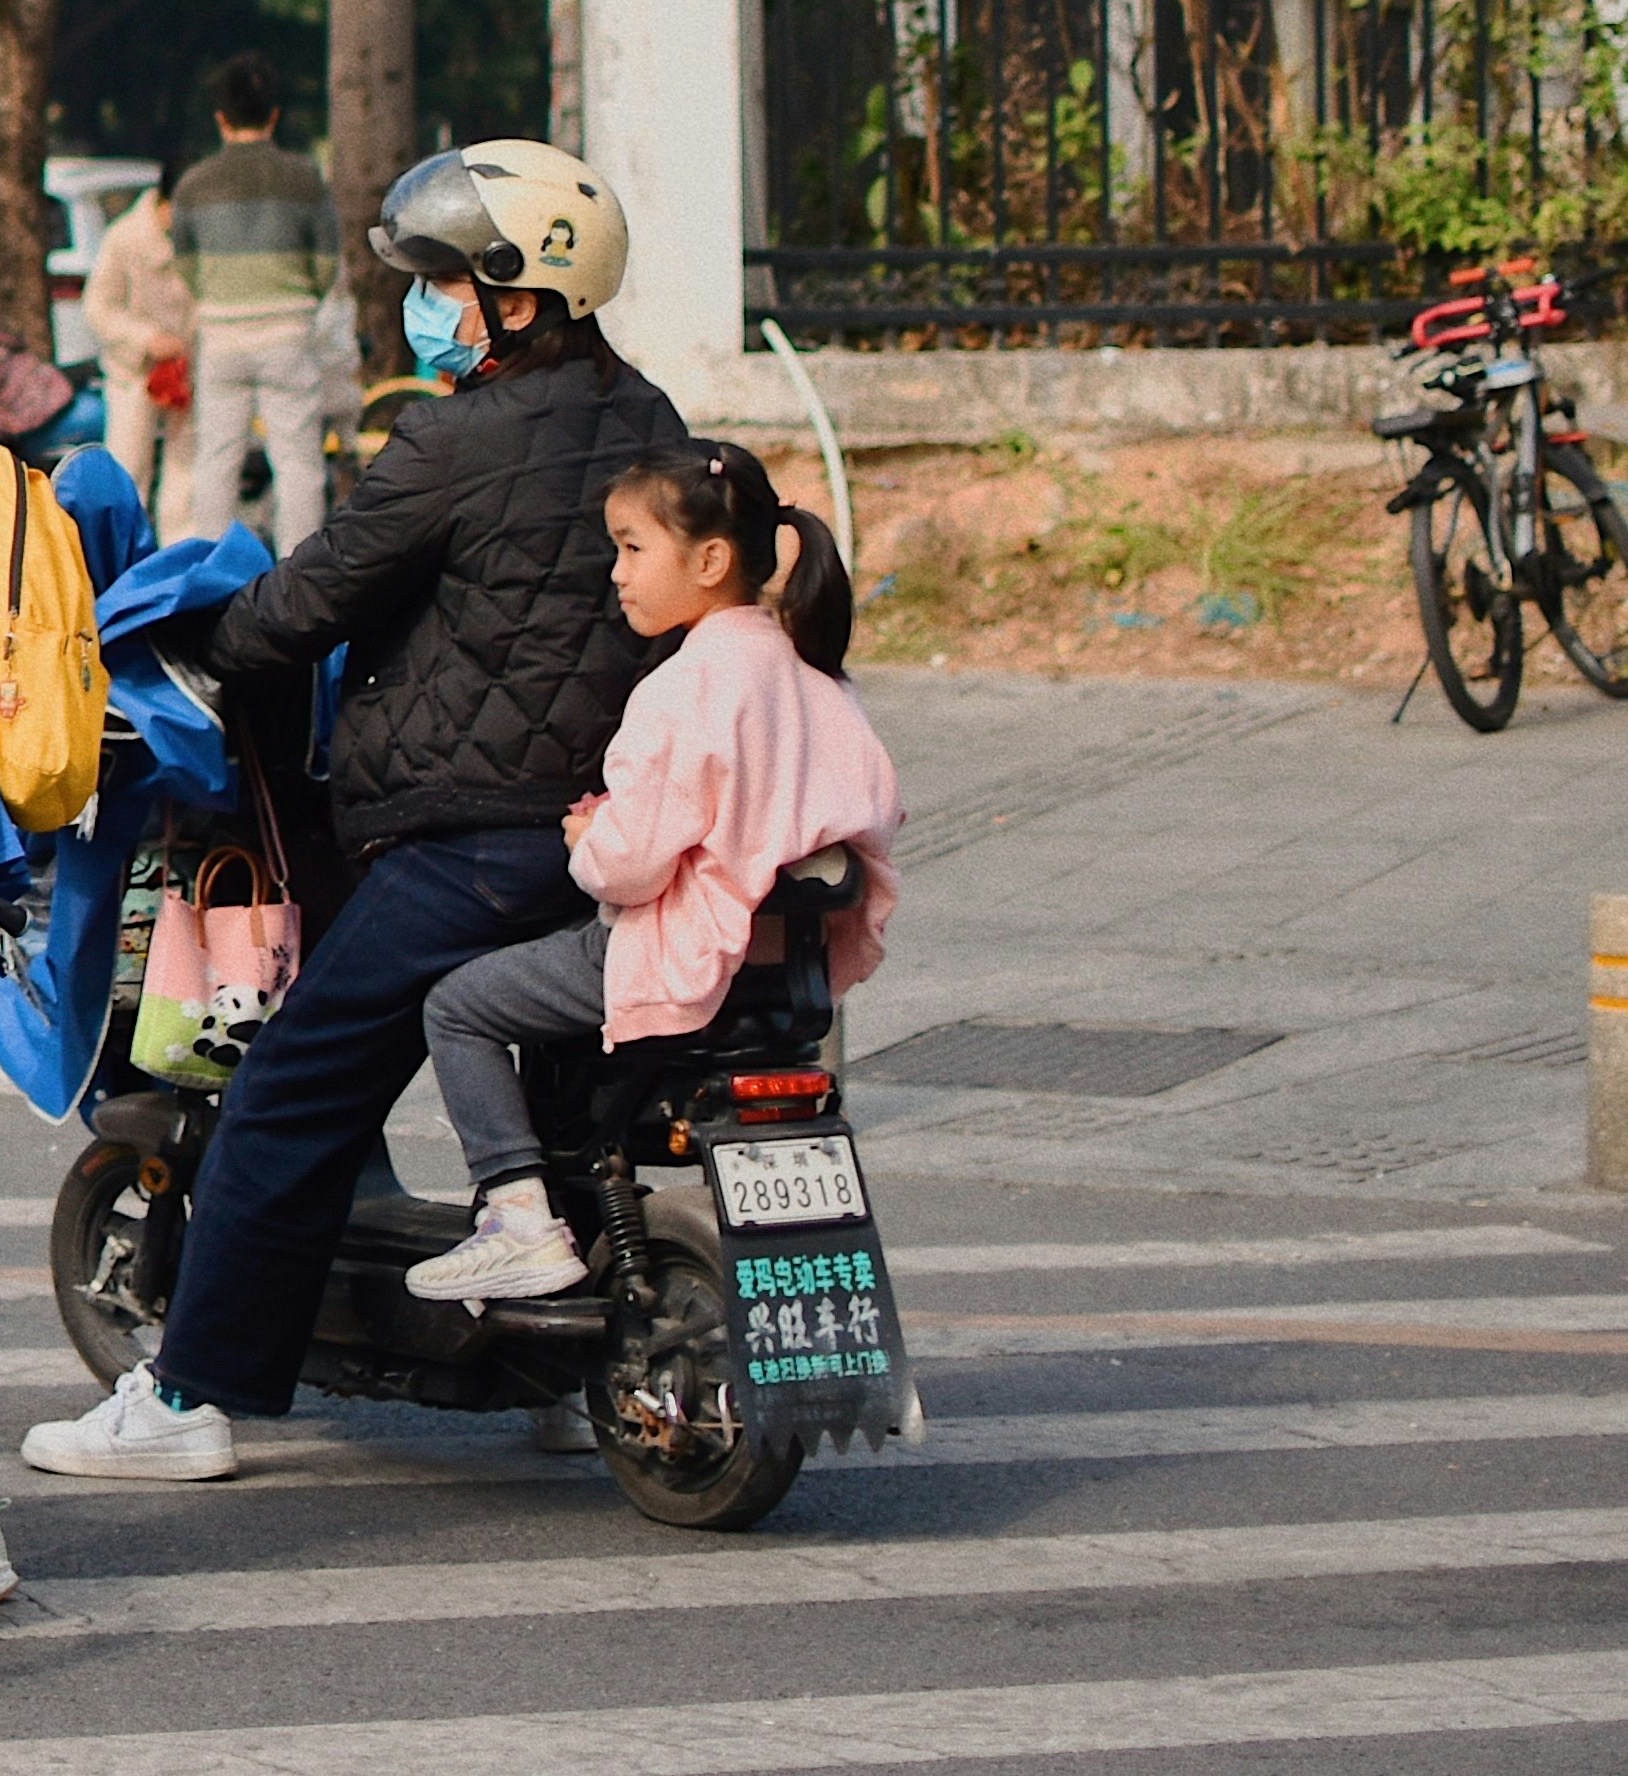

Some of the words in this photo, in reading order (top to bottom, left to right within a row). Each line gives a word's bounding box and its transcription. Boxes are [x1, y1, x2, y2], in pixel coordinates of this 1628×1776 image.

[733, 1173, 852, 1213] 289318
[735, 1249, 877, 1300] 爱玛电动车专卖
[744, 1293, 880, 1355] 兴旺车行
